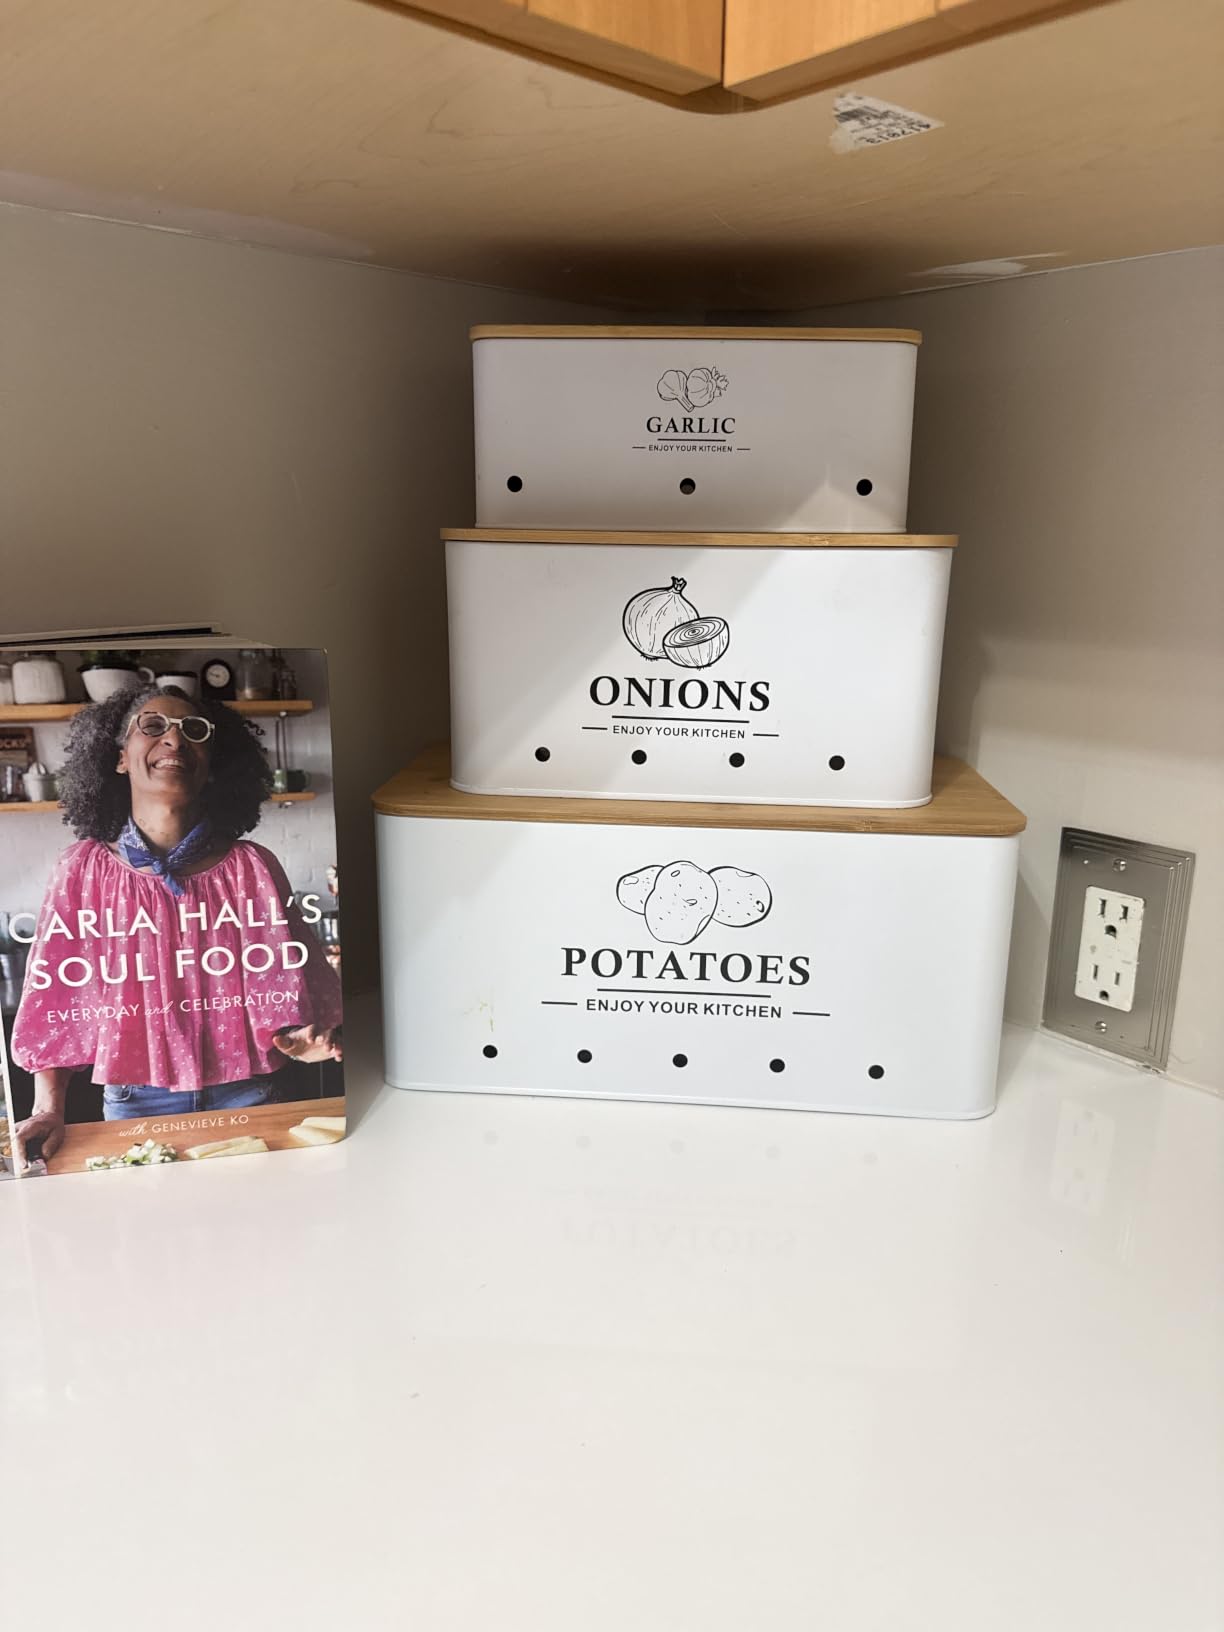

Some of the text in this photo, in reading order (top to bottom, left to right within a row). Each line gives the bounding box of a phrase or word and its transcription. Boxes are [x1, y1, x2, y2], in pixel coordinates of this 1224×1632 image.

[646, 416, 736, 434] GARLIC
[648, 444, 674, 452] ENJOY
[699, 445, 733, 453] KITCHEN
[589, 675, 770, 712] ONIONS
[613, 725, 745, 739] ENJOY YOUR KITCHEN
[9, 894, 322, 943] CARLA HALL'S
[30, 941, 309, 990] SOUL FOOD
[561, 947, 810, 986] POTATOES
[47, 990, 299, 1024] EVERYDAY and CELEBRATION
[586, 999, 782, 1018] ENJOY YOUR KITCHEN
[118, 1114, 249, 1138] with GENEVIEVE KO
